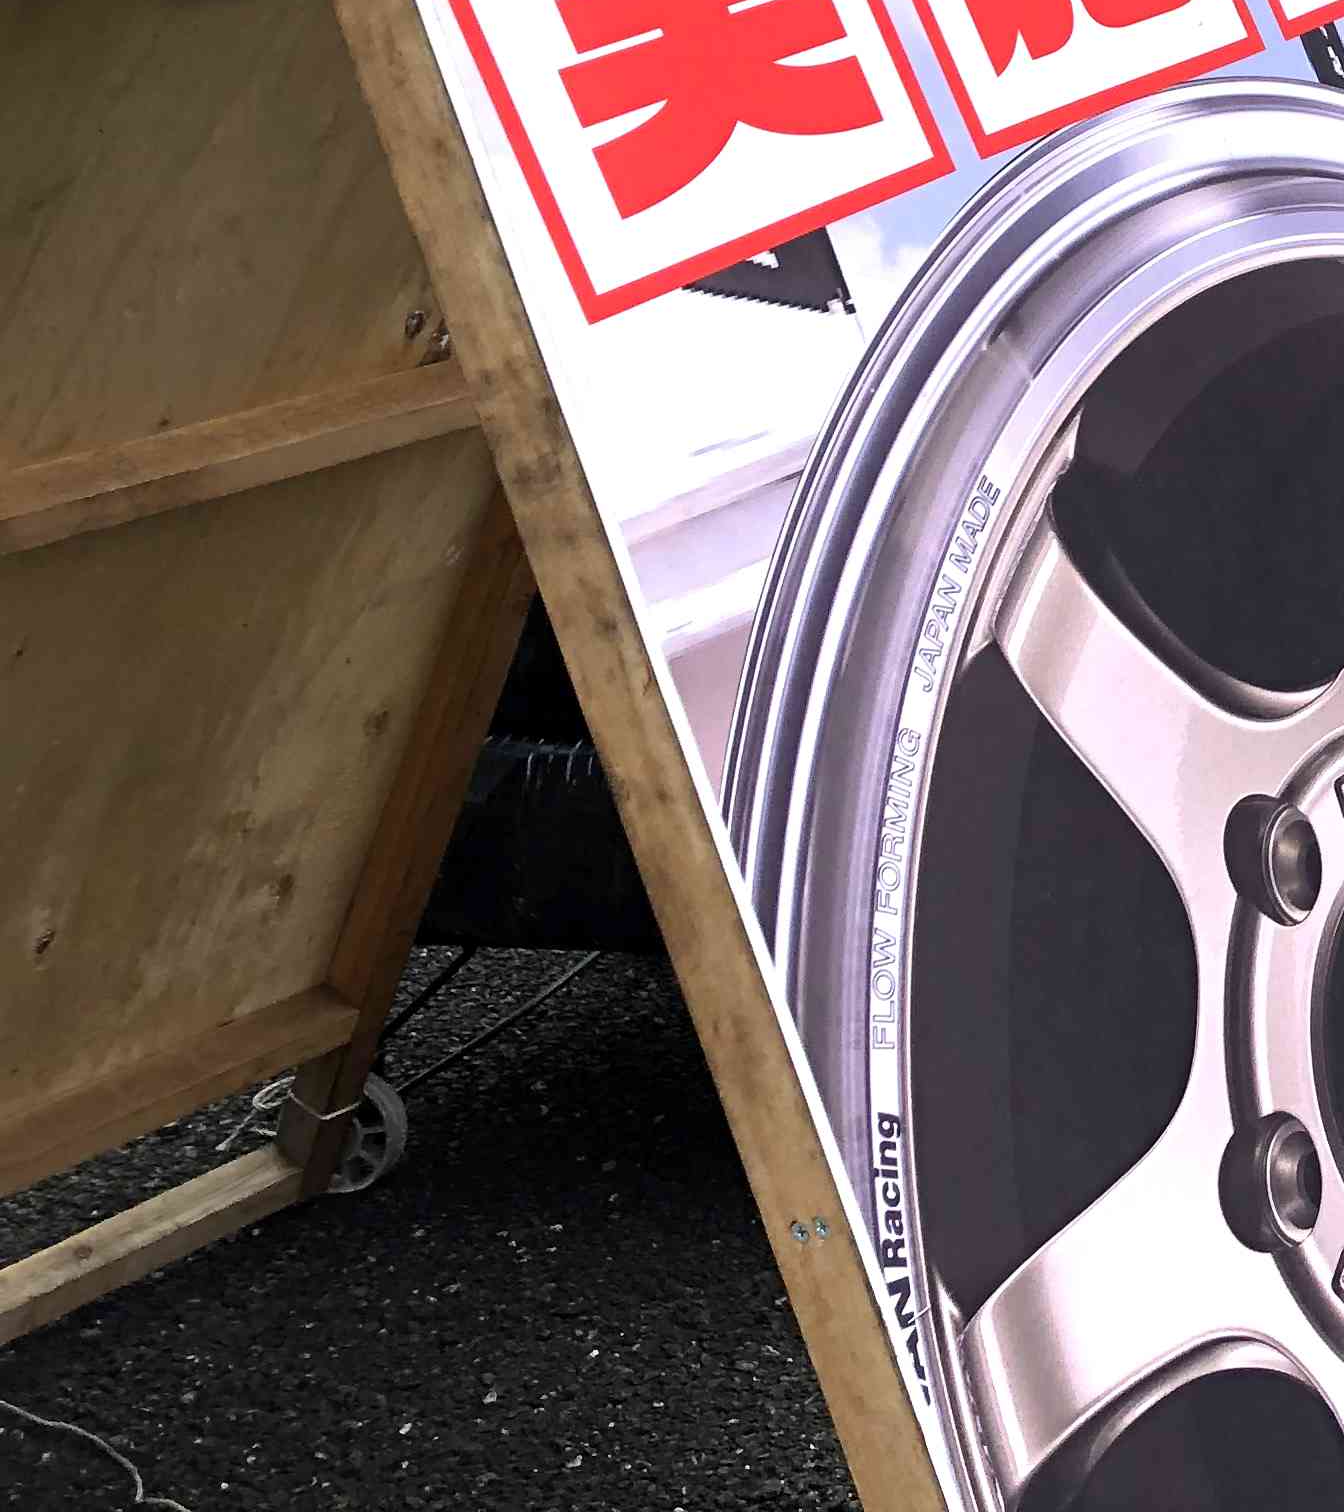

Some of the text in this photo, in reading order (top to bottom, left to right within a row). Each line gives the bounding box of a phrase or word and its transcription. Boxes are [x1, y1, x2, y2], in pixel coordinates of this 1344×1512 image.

[914, 474, 1001, 693] JAPAN MADE
[871, 726, 923, 1051] FLOW FORMING
[872, 1111, 909, 1269] Racing
